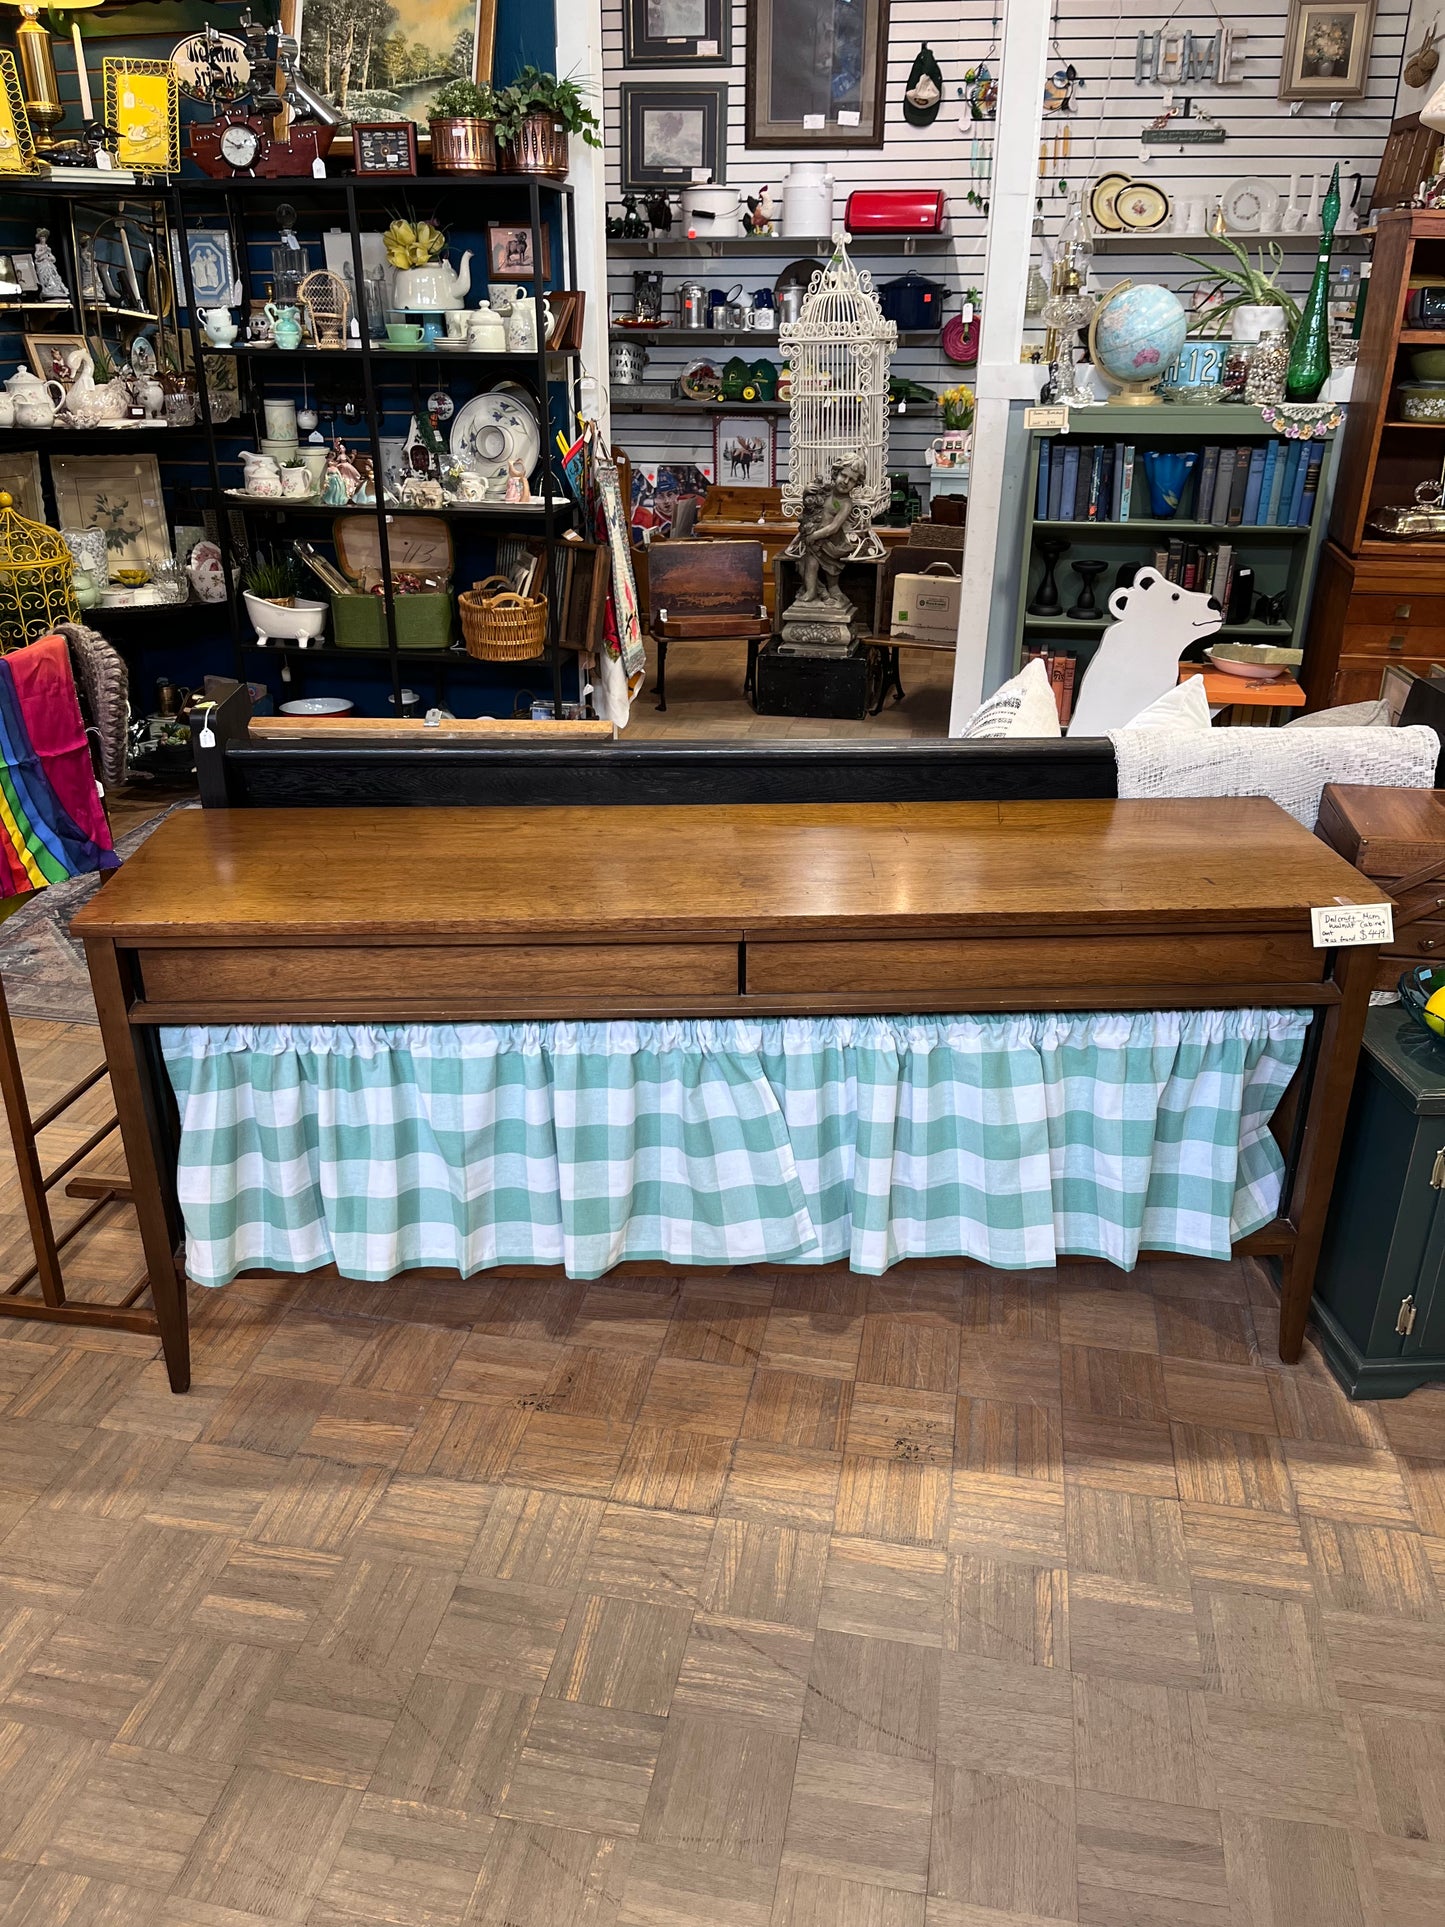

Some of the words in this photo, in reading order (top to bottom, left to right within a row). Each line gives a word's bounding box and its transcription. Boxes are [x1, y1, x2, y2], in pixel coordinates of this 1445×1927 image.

[186, 40, 240, 63] Welome
[1135, 28, 1248, 85] HOME
[610, 348, 642, 359] LOND
[616, 359, 643, 371] PARI
